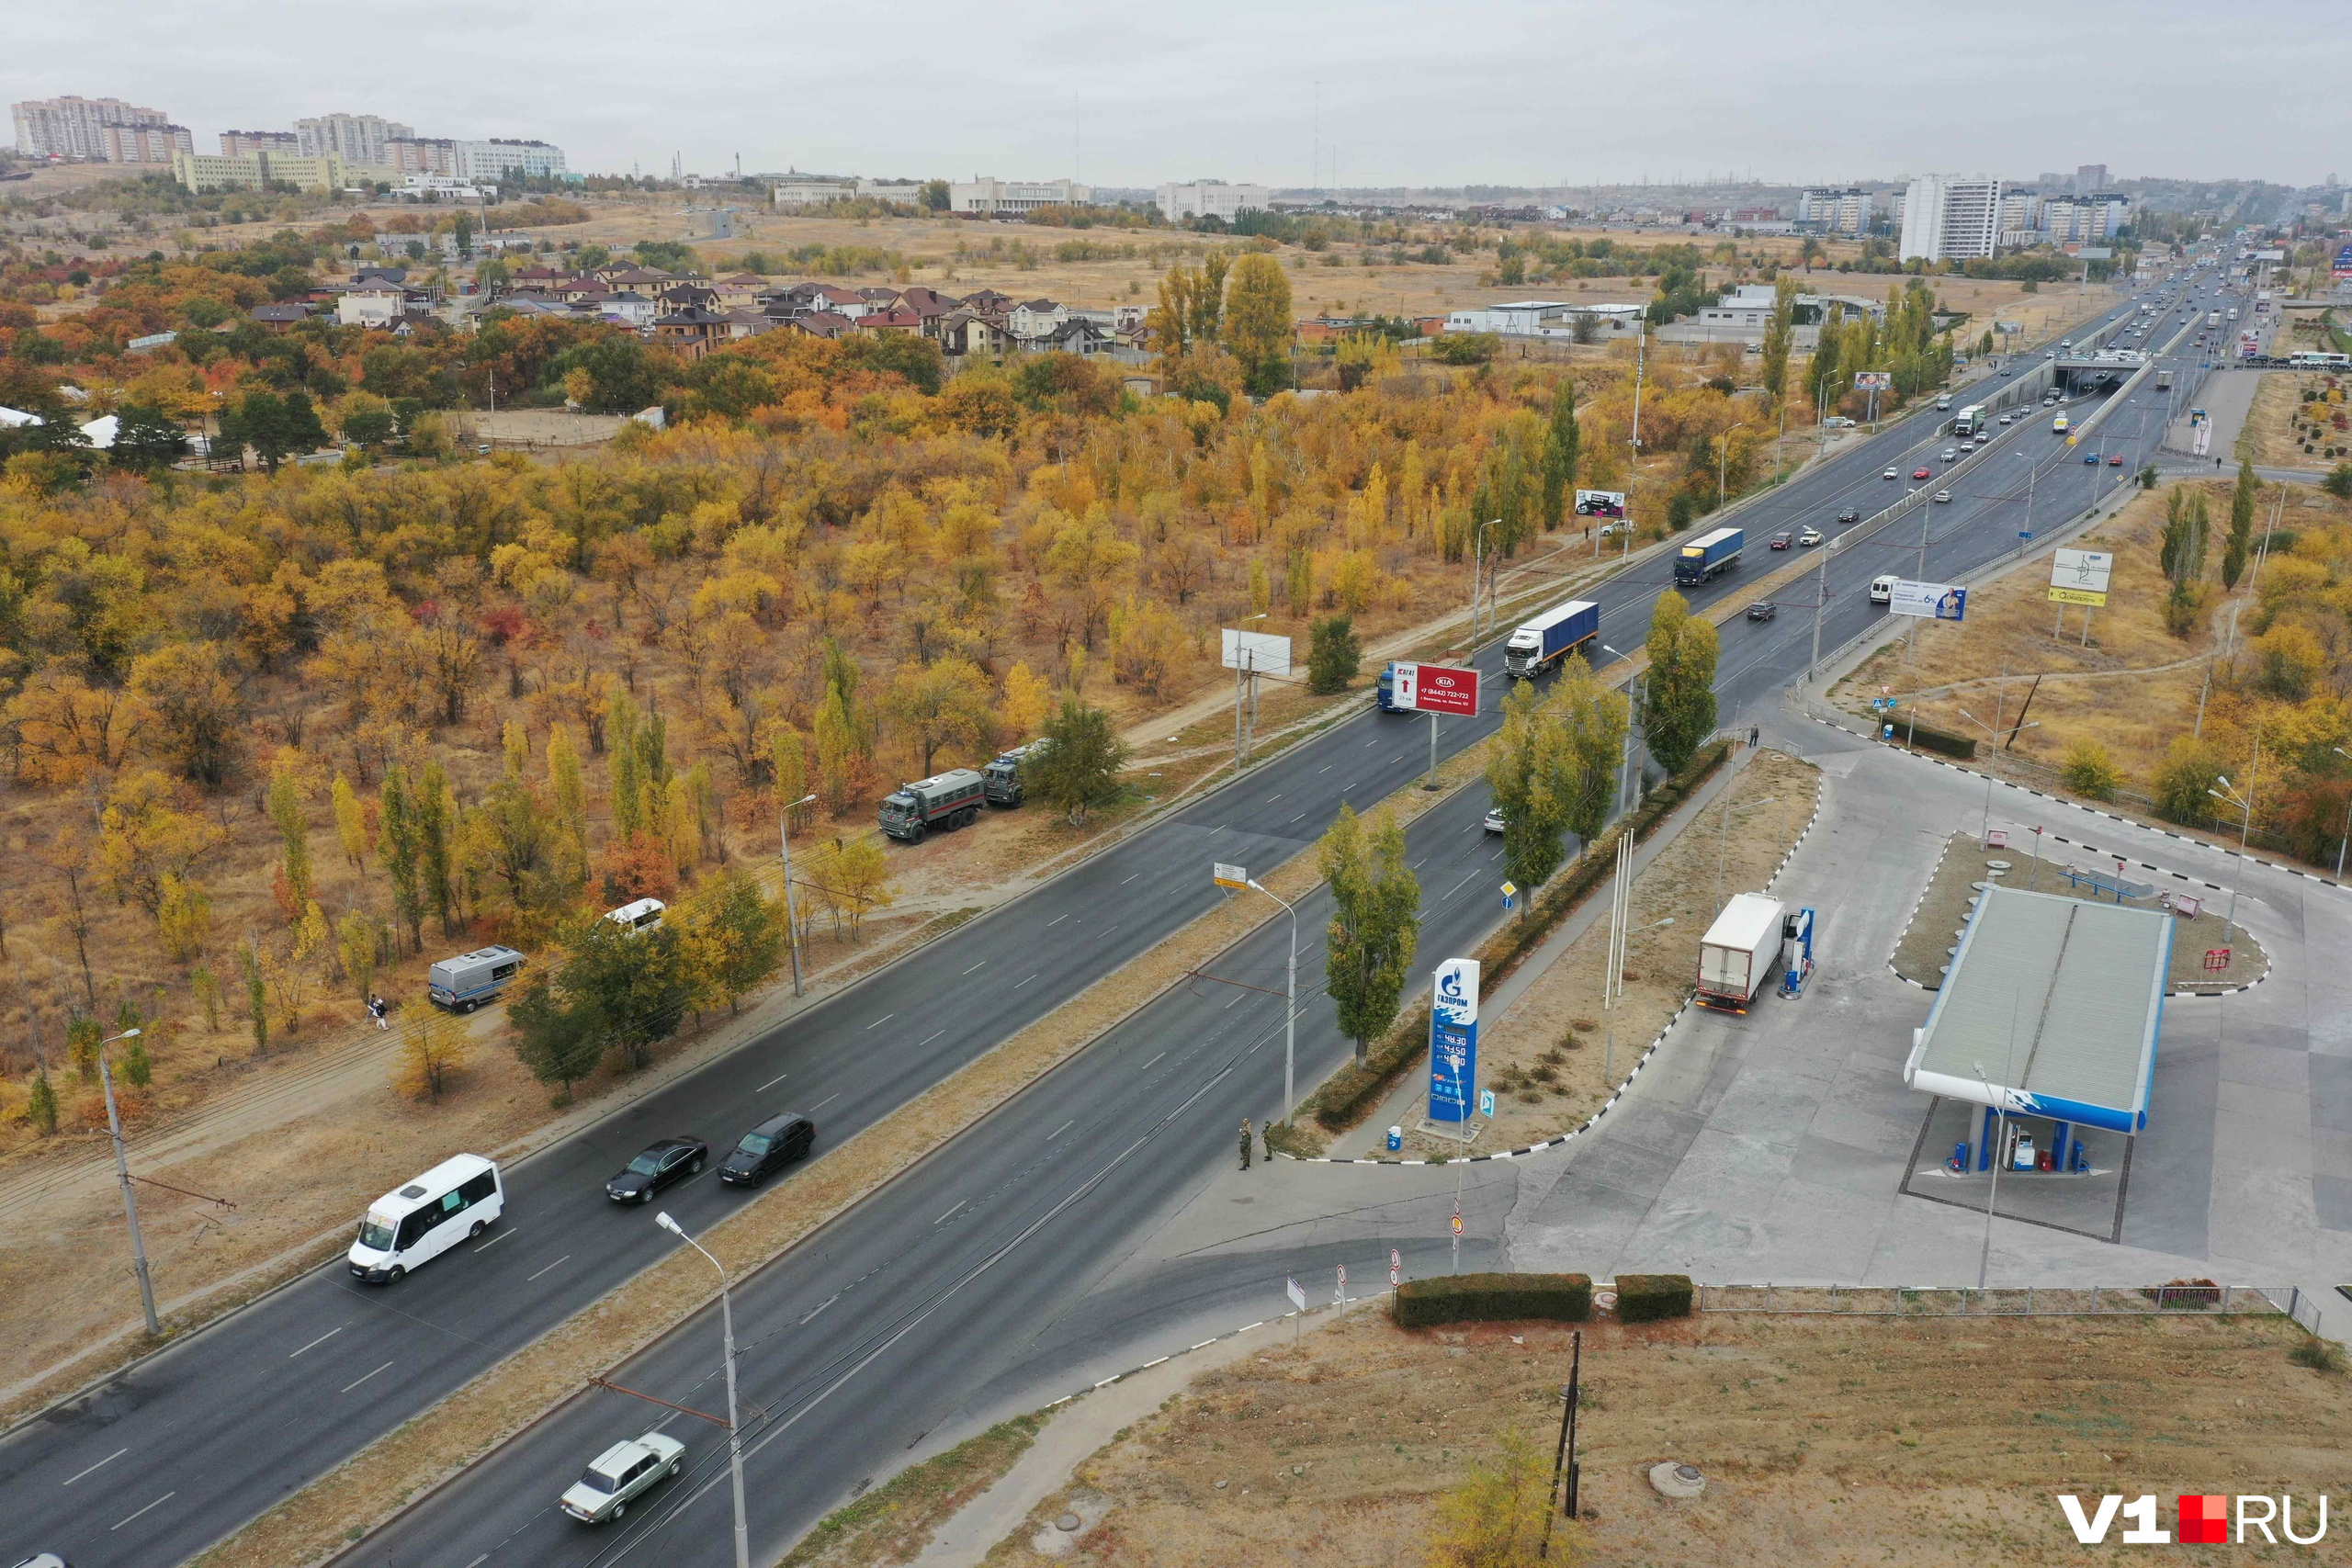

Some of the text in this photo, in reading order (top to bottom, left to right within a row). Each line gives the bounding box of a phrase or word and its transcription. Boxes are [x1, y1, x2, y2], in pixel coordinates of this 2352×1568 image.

[1924, 594, 1937, 604] 6%
[1438, 678, 1452, 686] KIA
[1428, 688, 1446, 696] (8442)
[1447, 691, 1469, 699] 722-722
[1437, 994, 1468, 1008] ГАЗПРОМ
[1444, 1034, 1466, 1045] 48.30
[1444, 1044, 1465, 1055] 43.50
